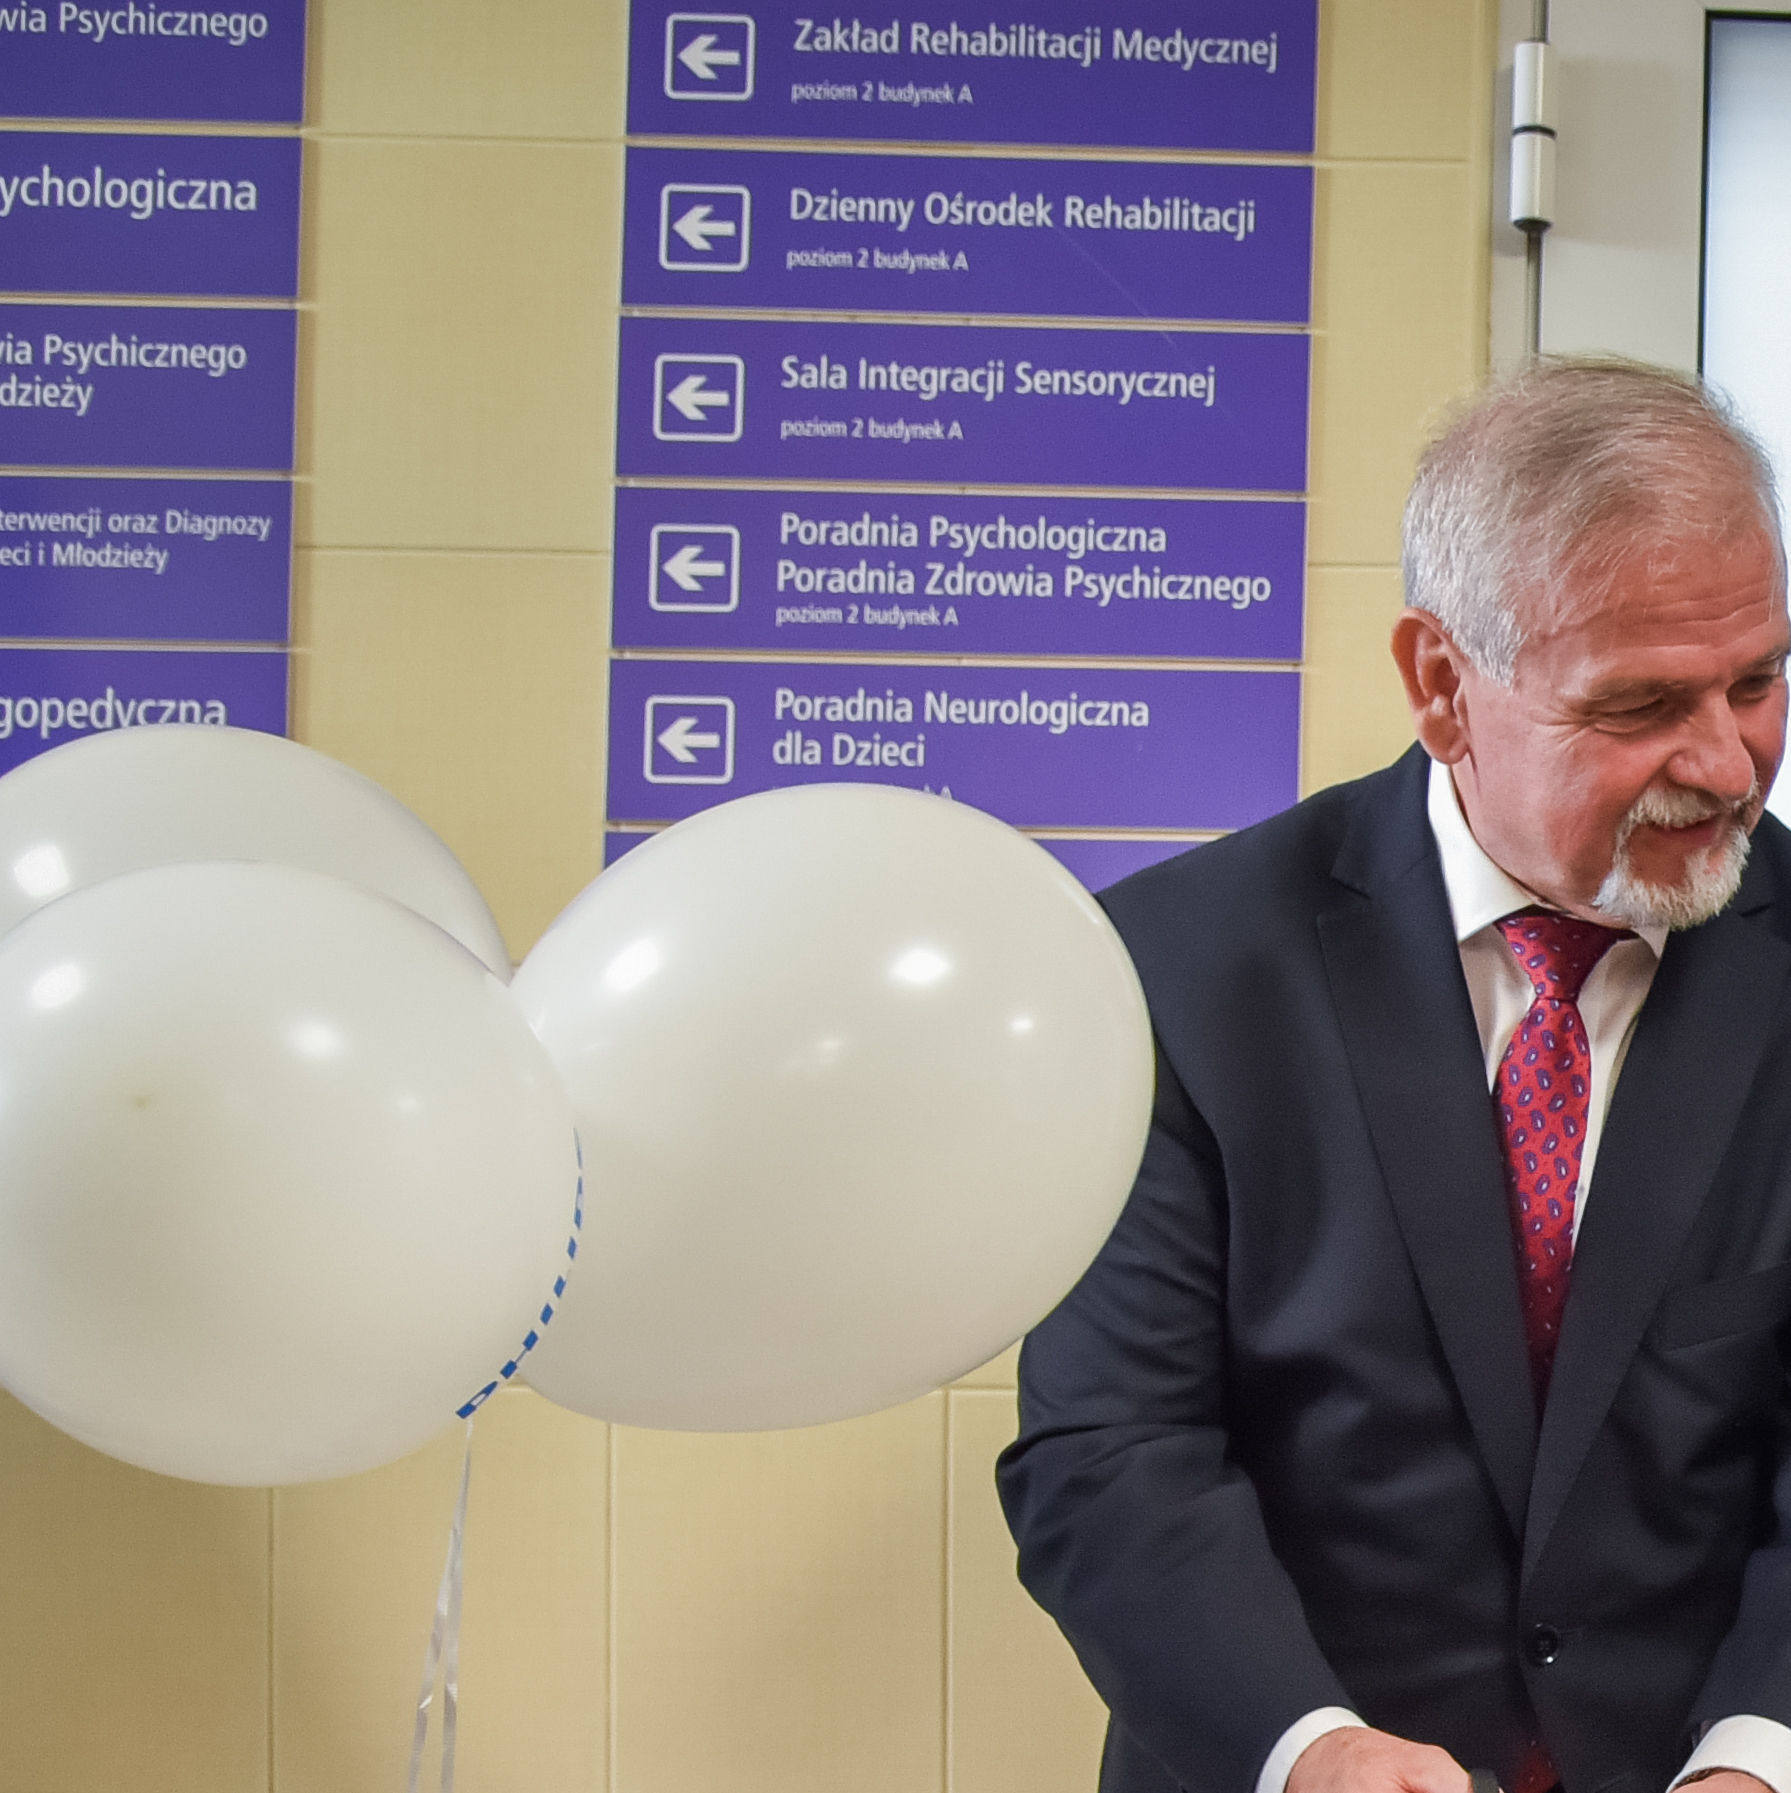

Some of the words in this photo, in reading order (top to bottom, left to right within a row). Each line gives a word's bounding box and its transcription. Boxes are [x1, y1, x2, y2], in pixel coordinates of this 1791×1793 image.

[59, 1, 268, 46] Psychicznego
[793, 18, 900, 54] Zakład
[910, 21, 1101, 68] Rehabilitacji
[1112, 28, 1277, 74] Medycznej
[790, 82, 858, 104] poziom
[861, 80, 874, 102] 2
[878, 81, 955, 108] budynek
[957, 84, 974, 104] A
[0, 164, 257, 220] ychologiczna
[790, 187, 915, 232] Dzienny
[924, 191, 1054, 228] Ośrodek
[1064, 195, 1255, 242] Rehabilitacji
[786, 248, 853, 270] poziom
[856, 247, 870, 269] 2
[873, 248, 950, 275] budynek
[952, 251, 969, 271] A
[0, 332, 33, 365] ia
[43, 333, 247, 378] Psychicznego
[0, 373, 94, 417] dzieży
[781, 354, 848, 390] Sala
[858, 357, 1005, 402] Integracji
[1014, 361, 1215, 408] Sensorycznej
[780, 418, 848, 440] poziom
[851, 417, 864, 439] 2
[867, 417, 945, 444] budynek
[947, 420, 964, 440] A
[107, 513, 159, 534] oraz
[165, 509, 271, 542] Diagnozy
[780, 512, 919, 548] Poradnia
[927, 515, 1167, 560] Psychologiczna
[38, 541, 45, 566] i
[52, 541, 169, 575] Młodzieży
[777, 559, 915, 595] Poradnia
[924, 561, 1054, 598] Zdrowia
[1064, 565, 1272, 610] Psychicznego
[775, 604, 843, 627] poziom
[846, 603, 859, 625] 2
[863, 603, 941, 630] budynek
[942, 605, 959, 626] A
[774, 687, 913, 723] Poradnia
[924, 690, 1149, 734] Neurologiczna
[772, 730, 822, 765] dla
[832, 732, 925, 767] Dzieci
